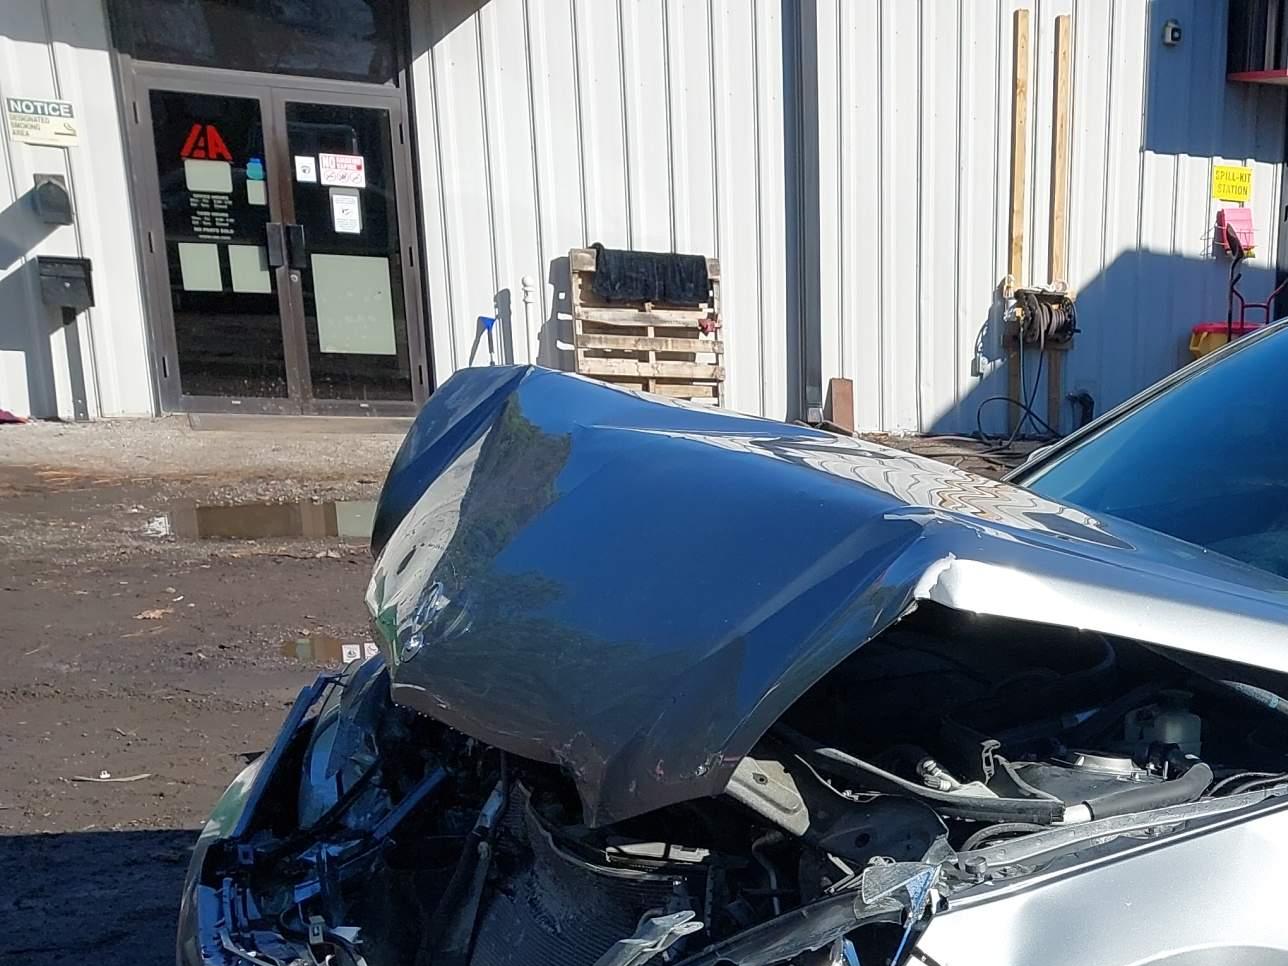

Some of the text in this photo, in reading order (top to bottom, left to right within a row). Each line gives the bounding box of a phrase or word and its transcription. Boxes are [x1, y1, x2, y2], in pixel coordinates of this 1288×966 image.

[9, 100, 72, 117] NOTICE
[1215, 170, 1252, 183] SPILL-KIT
[1217, 184, 1248, 195] STATION
